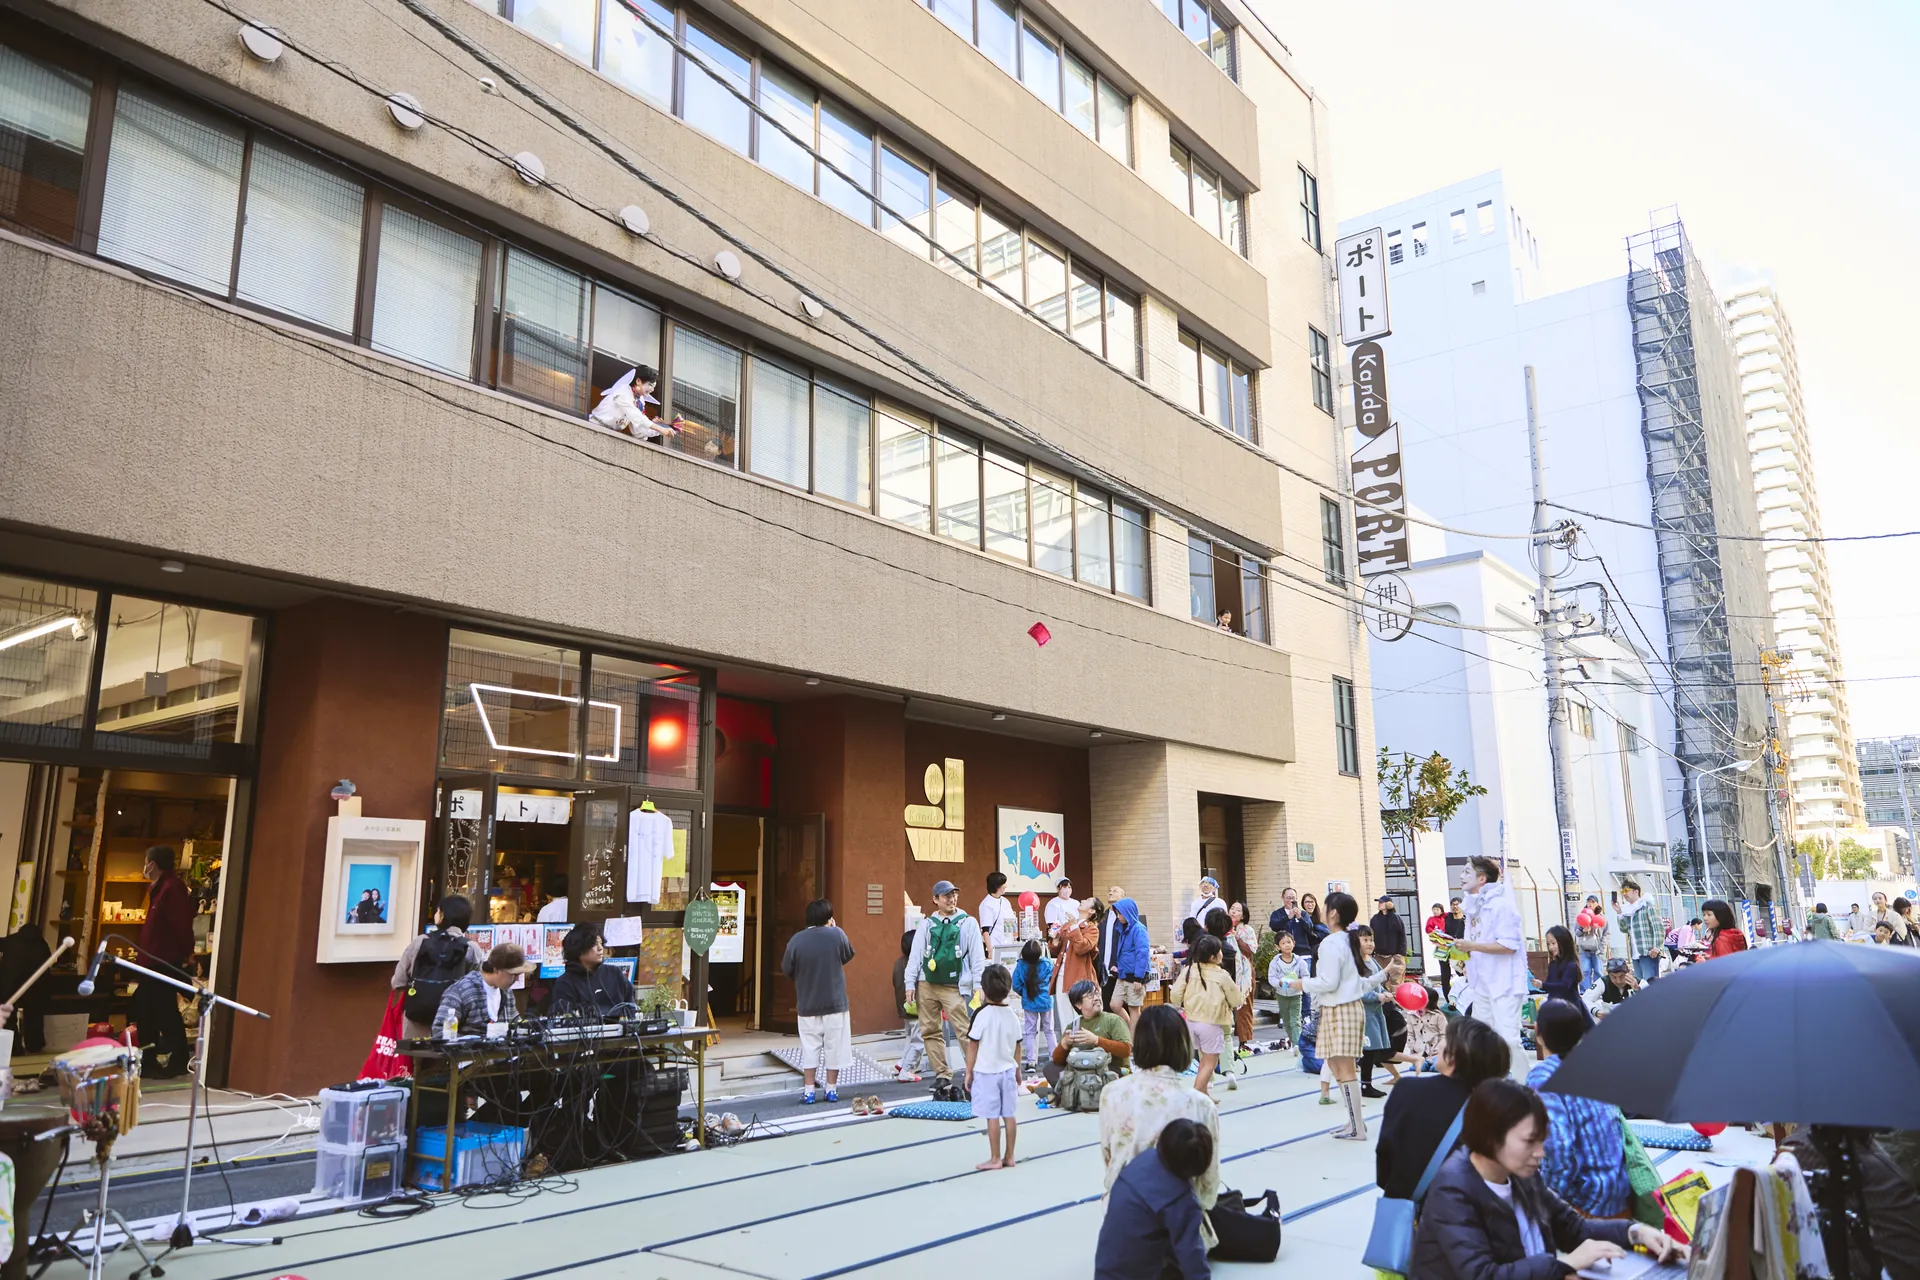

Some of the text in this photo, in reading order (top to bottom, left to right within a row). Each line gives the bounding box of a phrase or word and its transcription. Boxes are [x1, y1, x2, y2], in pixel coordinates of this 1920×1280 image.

[1346, 238, 1374, 332] ポート
[1358, 354, 1382, 425] Kanda
[1352, 452, 1409, 570] PORT
[1374, 581, 1398, 633] 神田
[909, 808, 940, 823] Kanda
[948, 764, 960, 824] ポート
[917, 831, 963, 861] PORT
